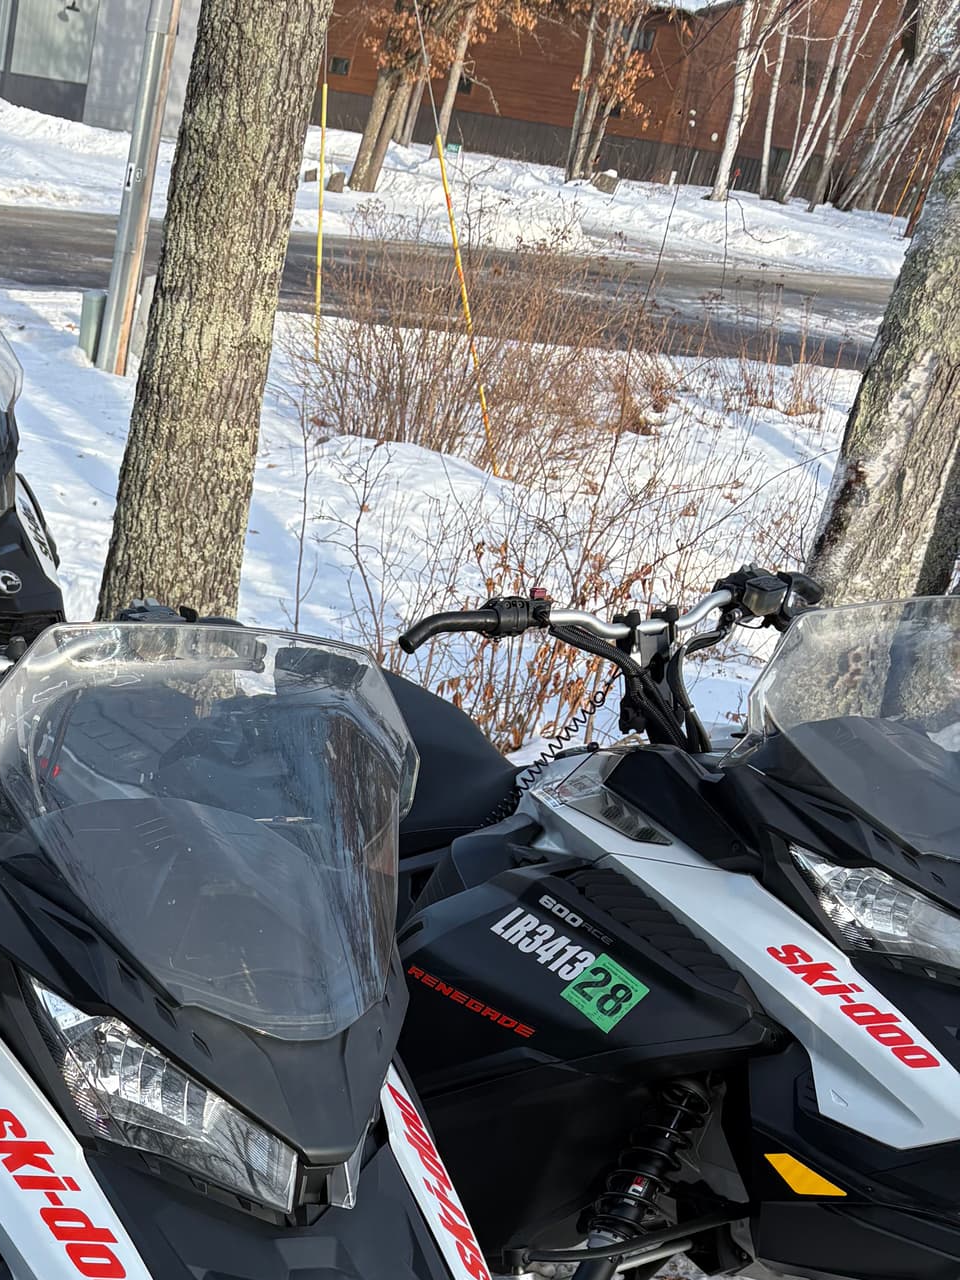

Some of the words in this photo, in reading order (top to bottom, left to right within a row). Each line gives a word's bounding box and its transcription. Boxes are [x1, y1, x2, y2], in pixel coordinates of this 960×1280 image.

[490, 906, 596, 982] LR3413
[538, 894, 584, 928] 600
[407, 965, 537, 1039] RENEGADE
[572, 966, 634, 1018] 28
[766, 944, 941, 1069] ski-doo
